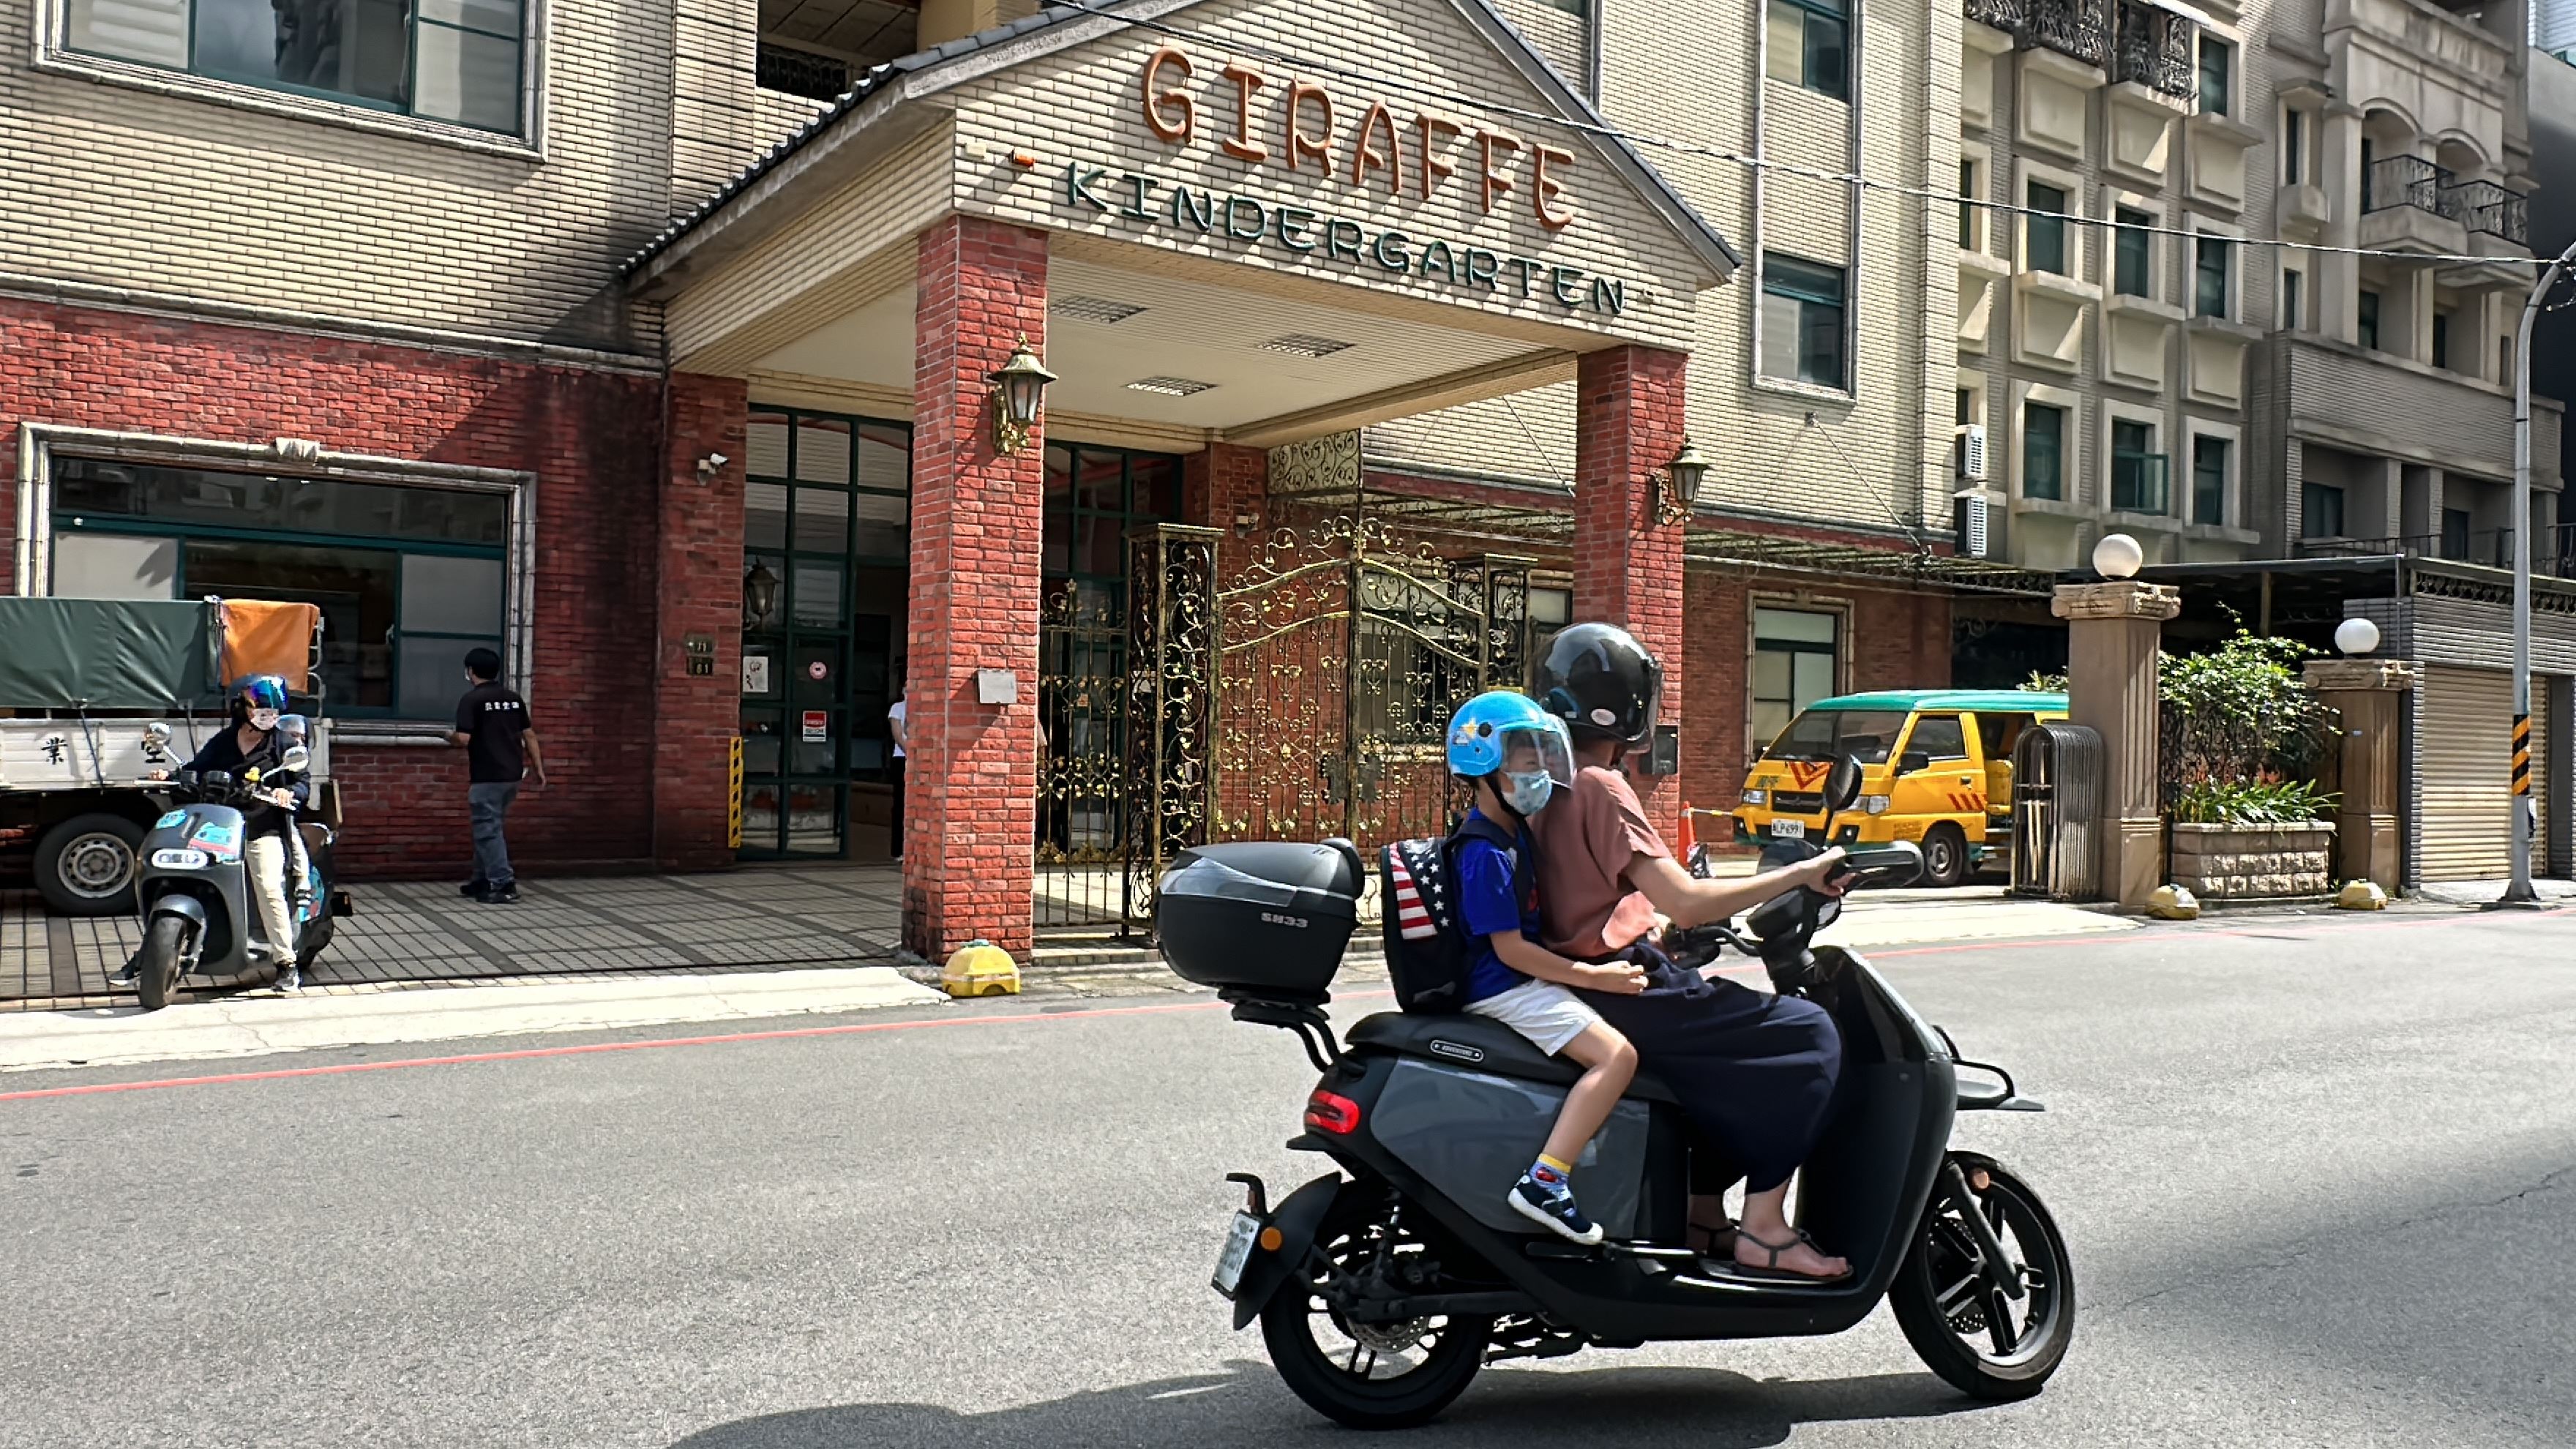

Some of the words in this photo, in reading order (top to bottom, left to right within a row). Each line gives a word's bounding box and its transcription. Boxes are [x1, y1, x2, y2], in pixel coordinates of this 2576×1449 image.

[1142, 45, 1576, 231] GIRAFFE
[1067, 160, 1627, 315] KINDERGARTEN
[40, 737, 68, 765] 業
[1261, 912, 1308, 928] SH33
